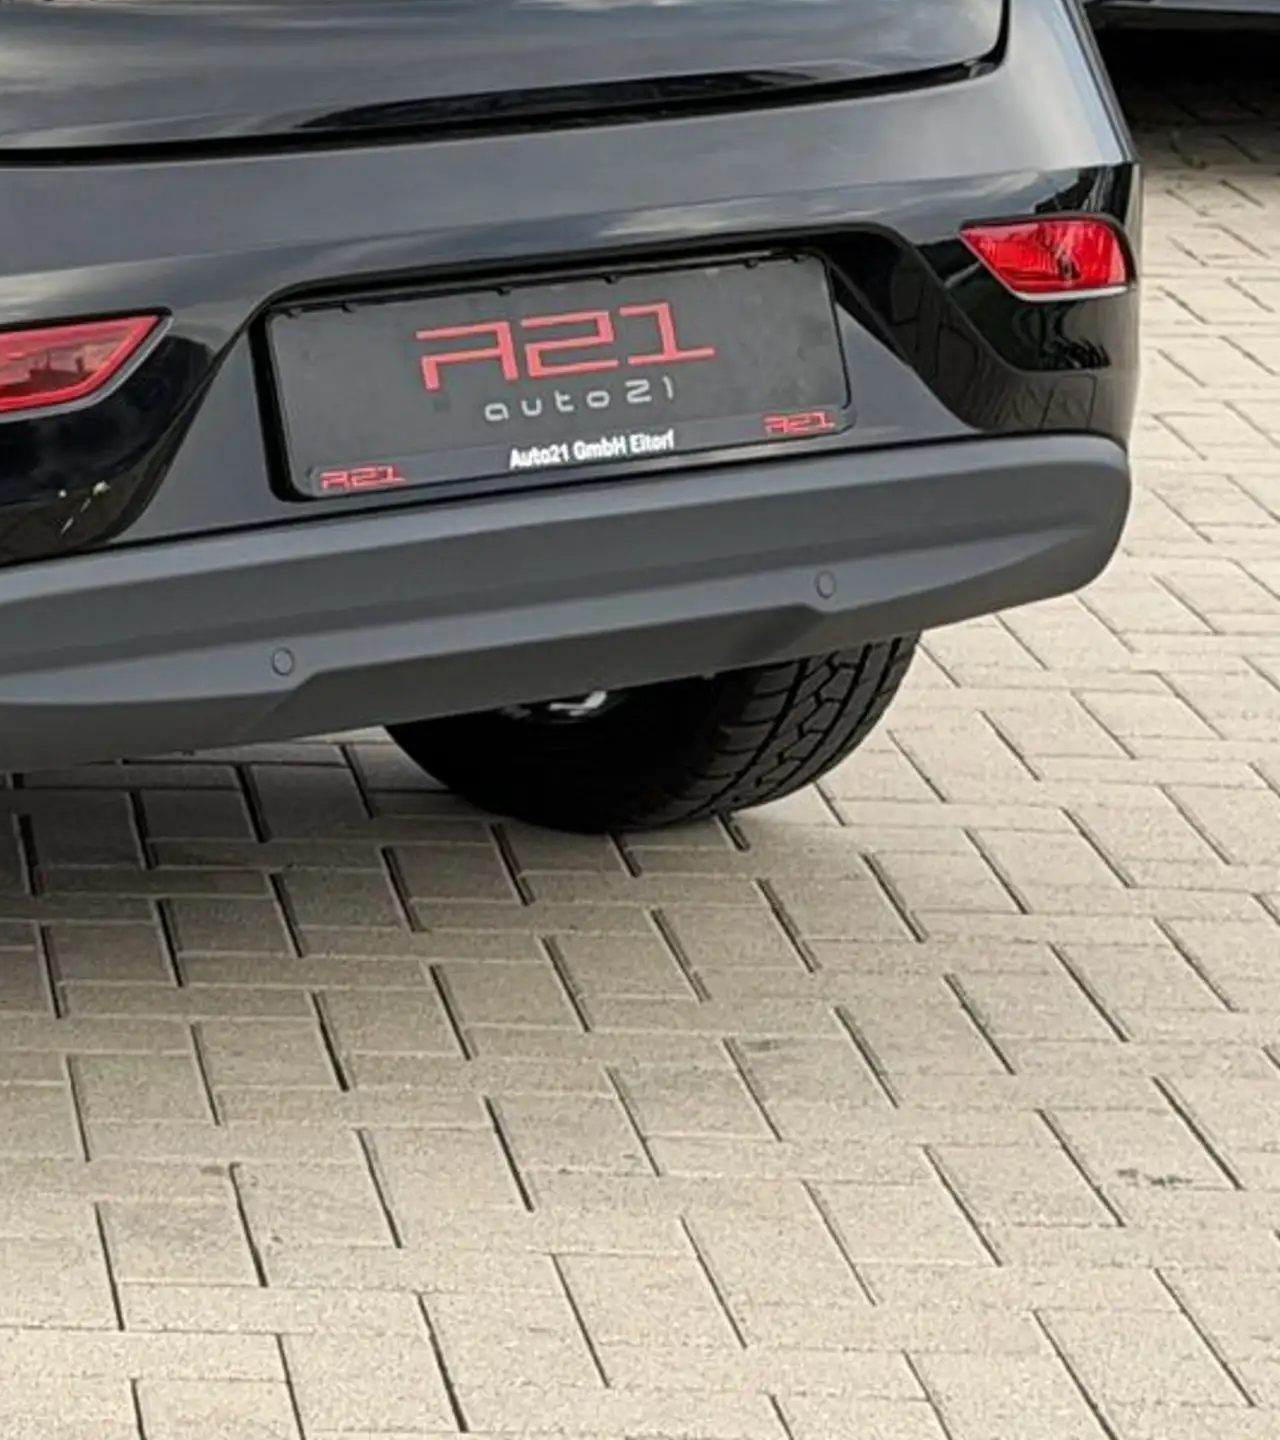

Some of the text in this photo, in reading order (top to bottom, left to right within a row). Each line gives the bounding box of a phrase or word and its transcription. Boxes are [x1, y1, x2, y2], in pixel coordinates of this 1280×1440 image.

[509, 428, 676, 470] Auto21 GmbH Eitorf
